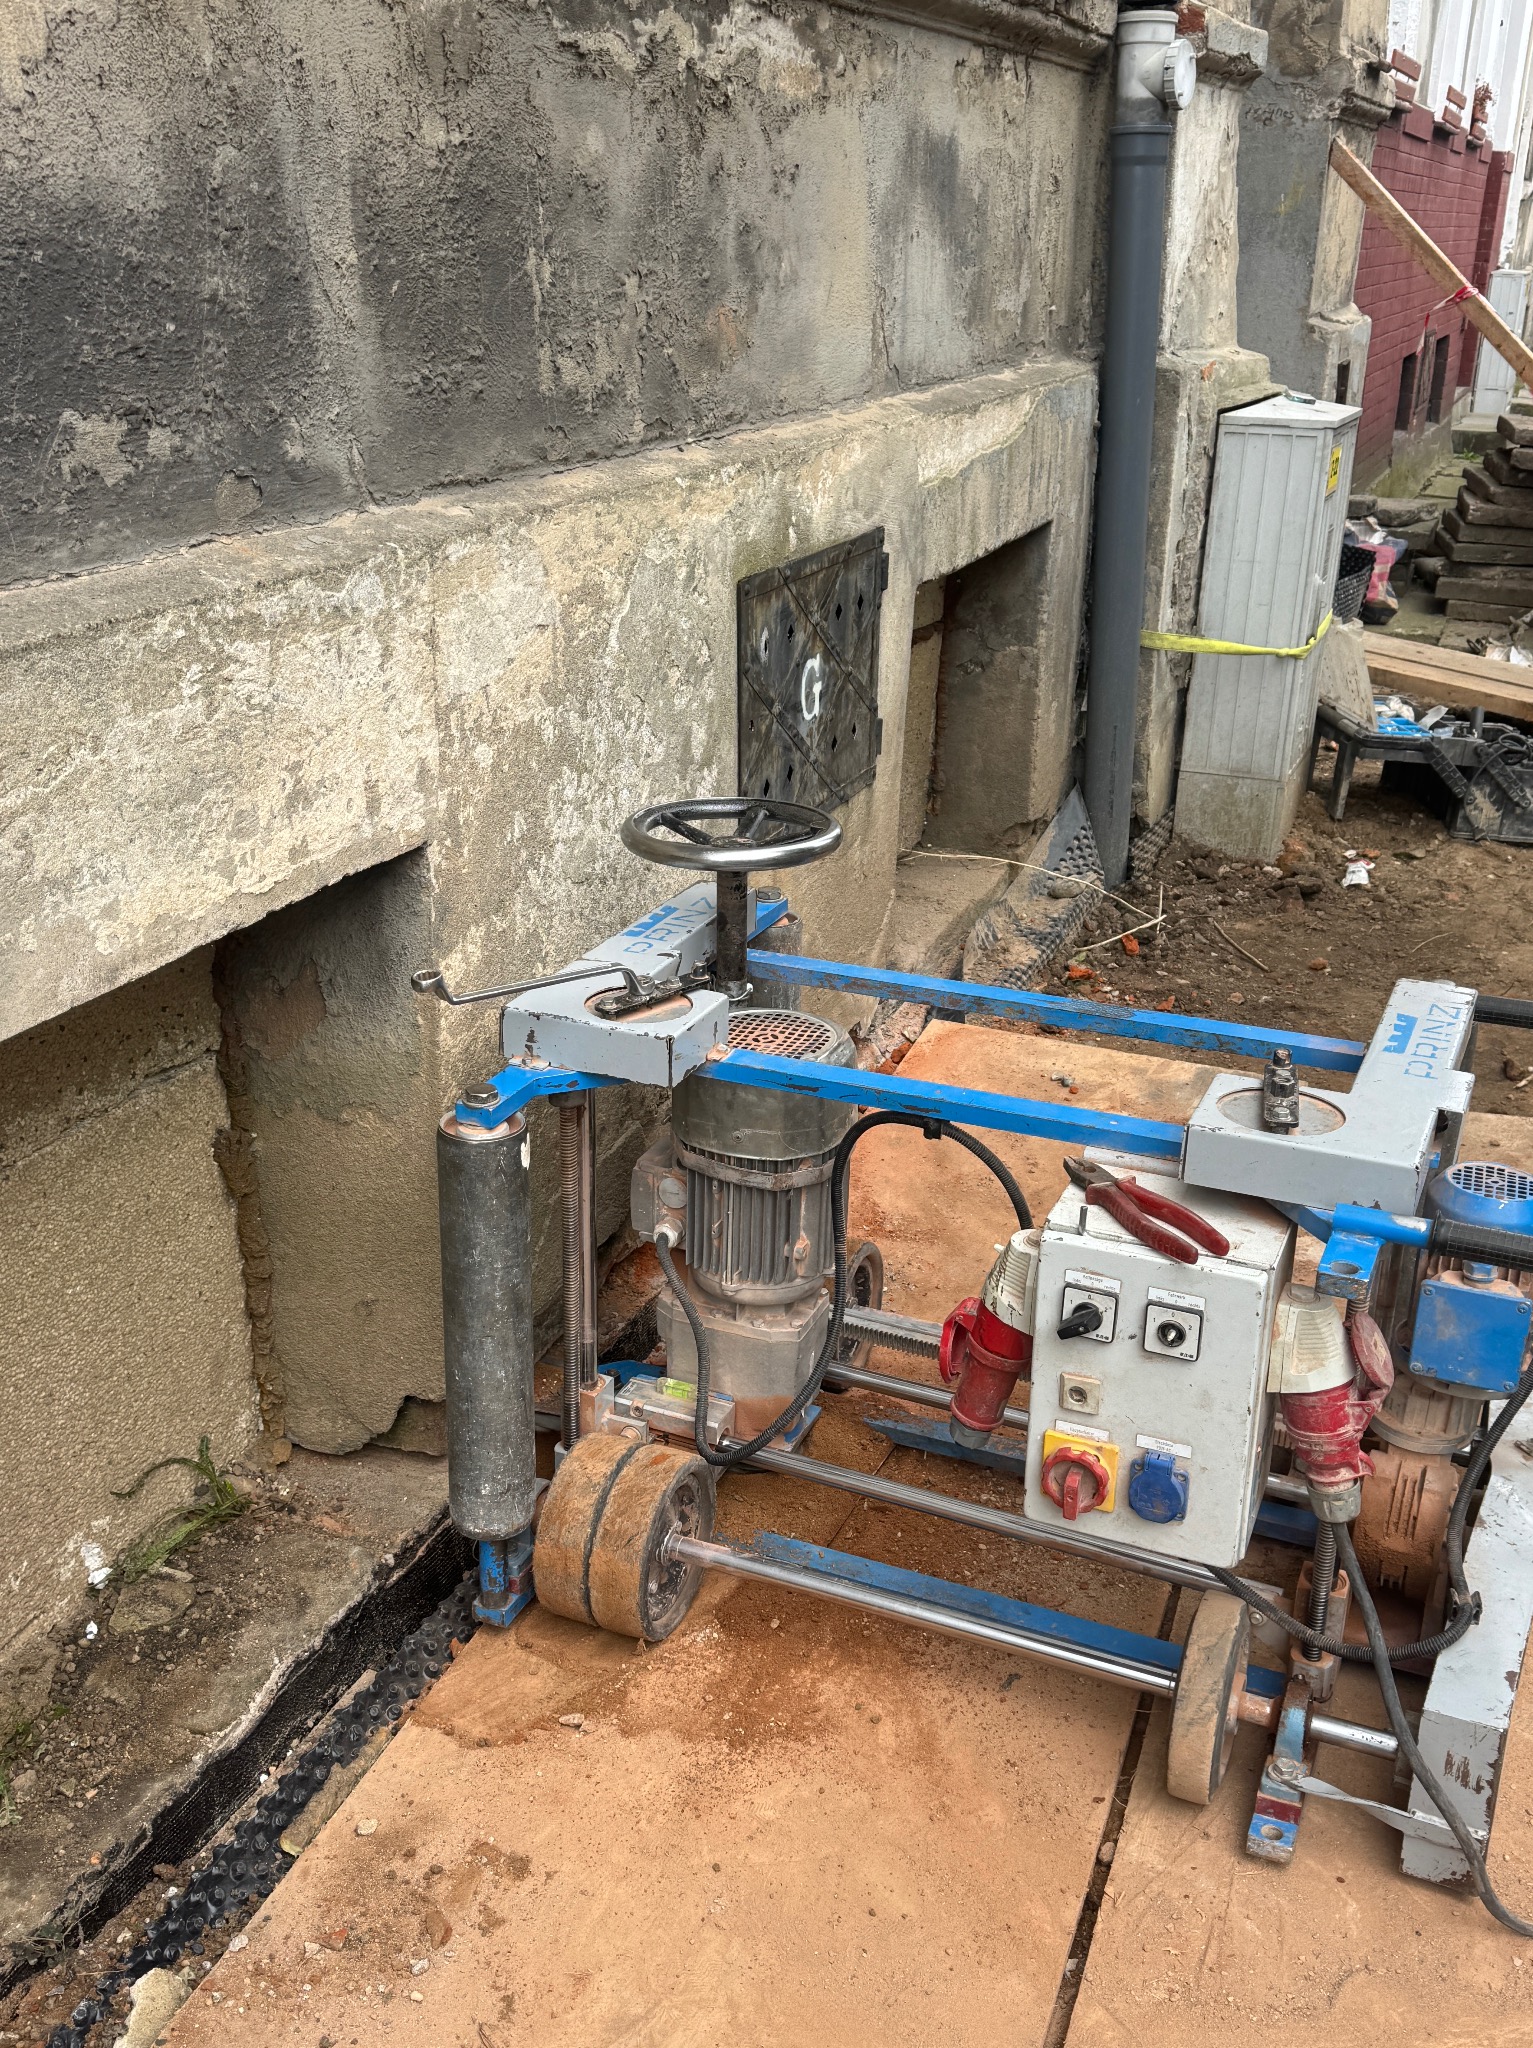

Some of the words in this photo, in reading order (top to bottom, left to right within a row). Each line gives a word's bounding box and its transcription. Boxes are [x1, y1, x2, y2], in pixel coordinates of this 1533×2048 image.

[801, 653, 822, 721] G
[623, 897, 716, 954] PRINZ
[1403, 1003, 1463, 1080] PRINZ
